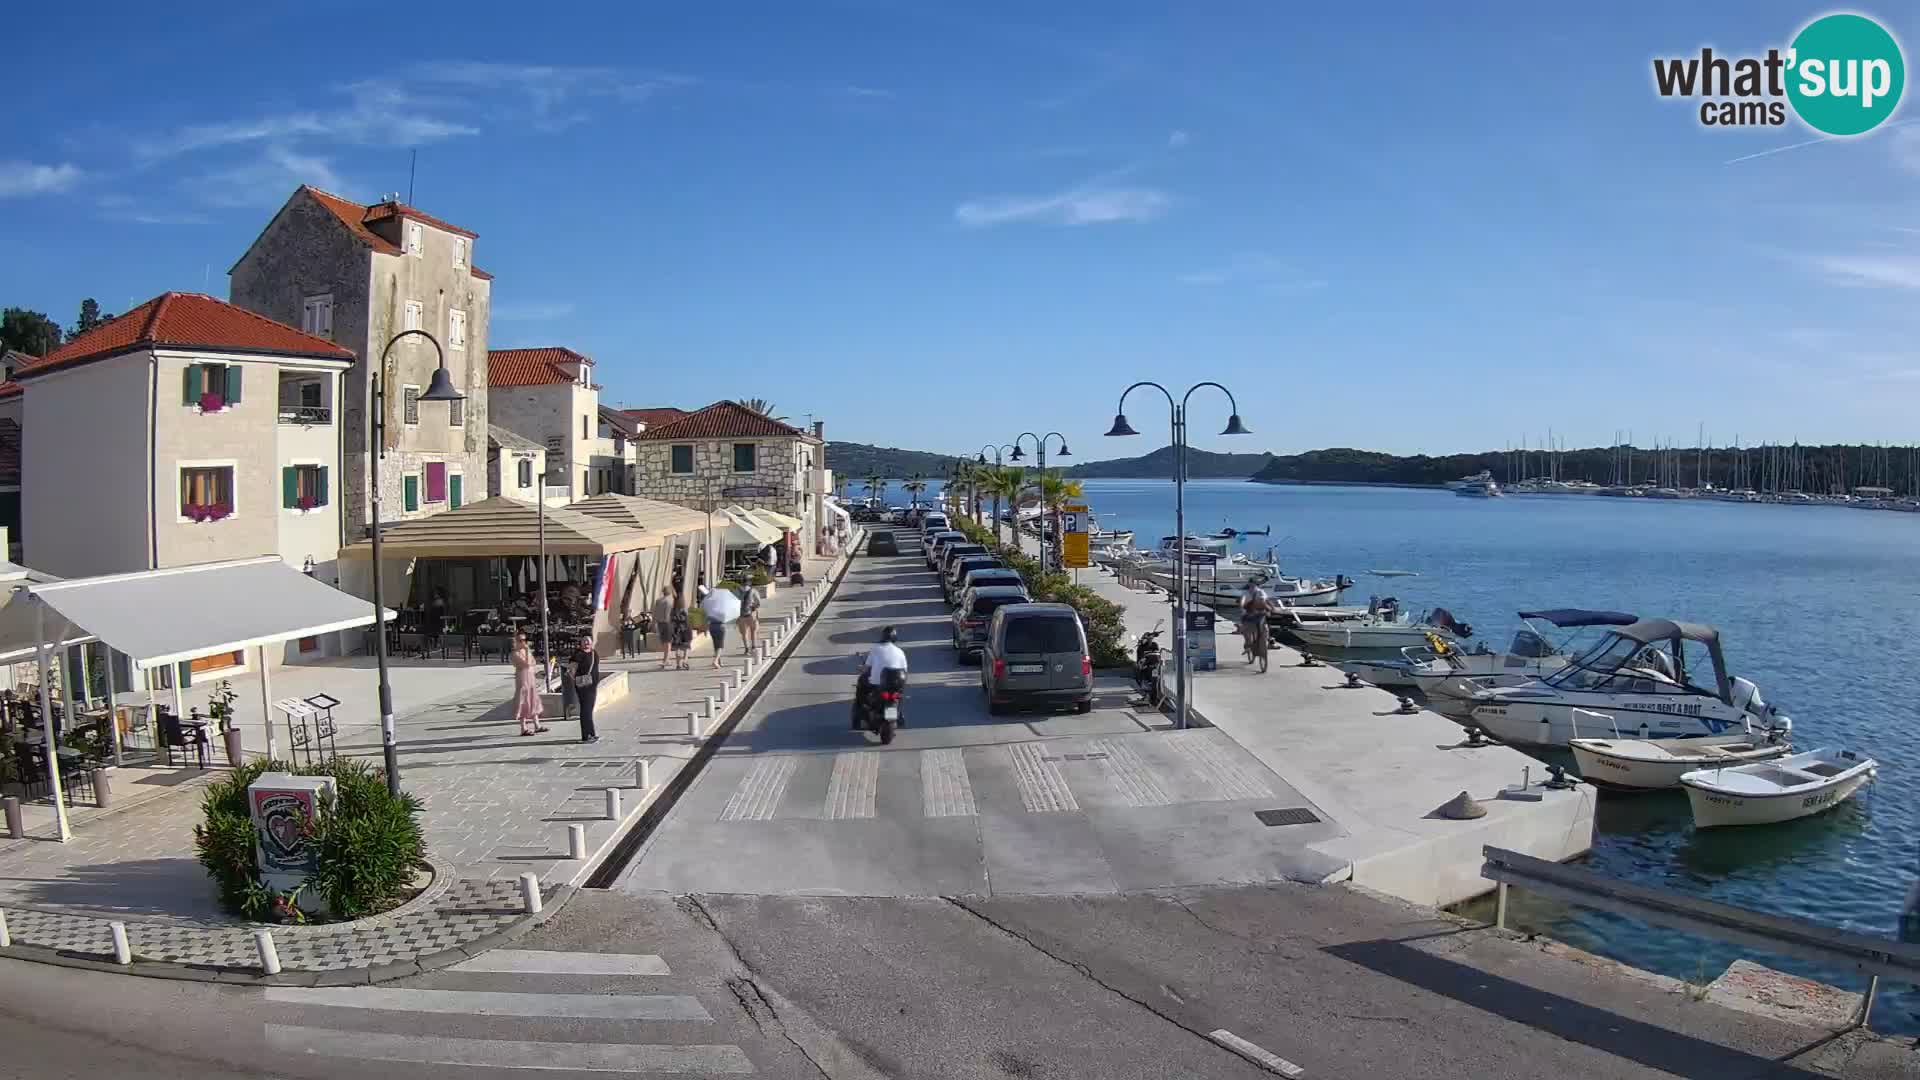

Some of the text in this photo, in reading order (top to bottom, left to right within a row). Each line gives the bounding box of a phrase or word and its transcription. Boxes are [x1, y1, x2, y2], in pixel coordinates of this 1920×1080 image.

[1065, 515, 1075, 530] P
[1656, 703, 1676, 713] RENT
[1683, 704, 1703, 716] BOAT
